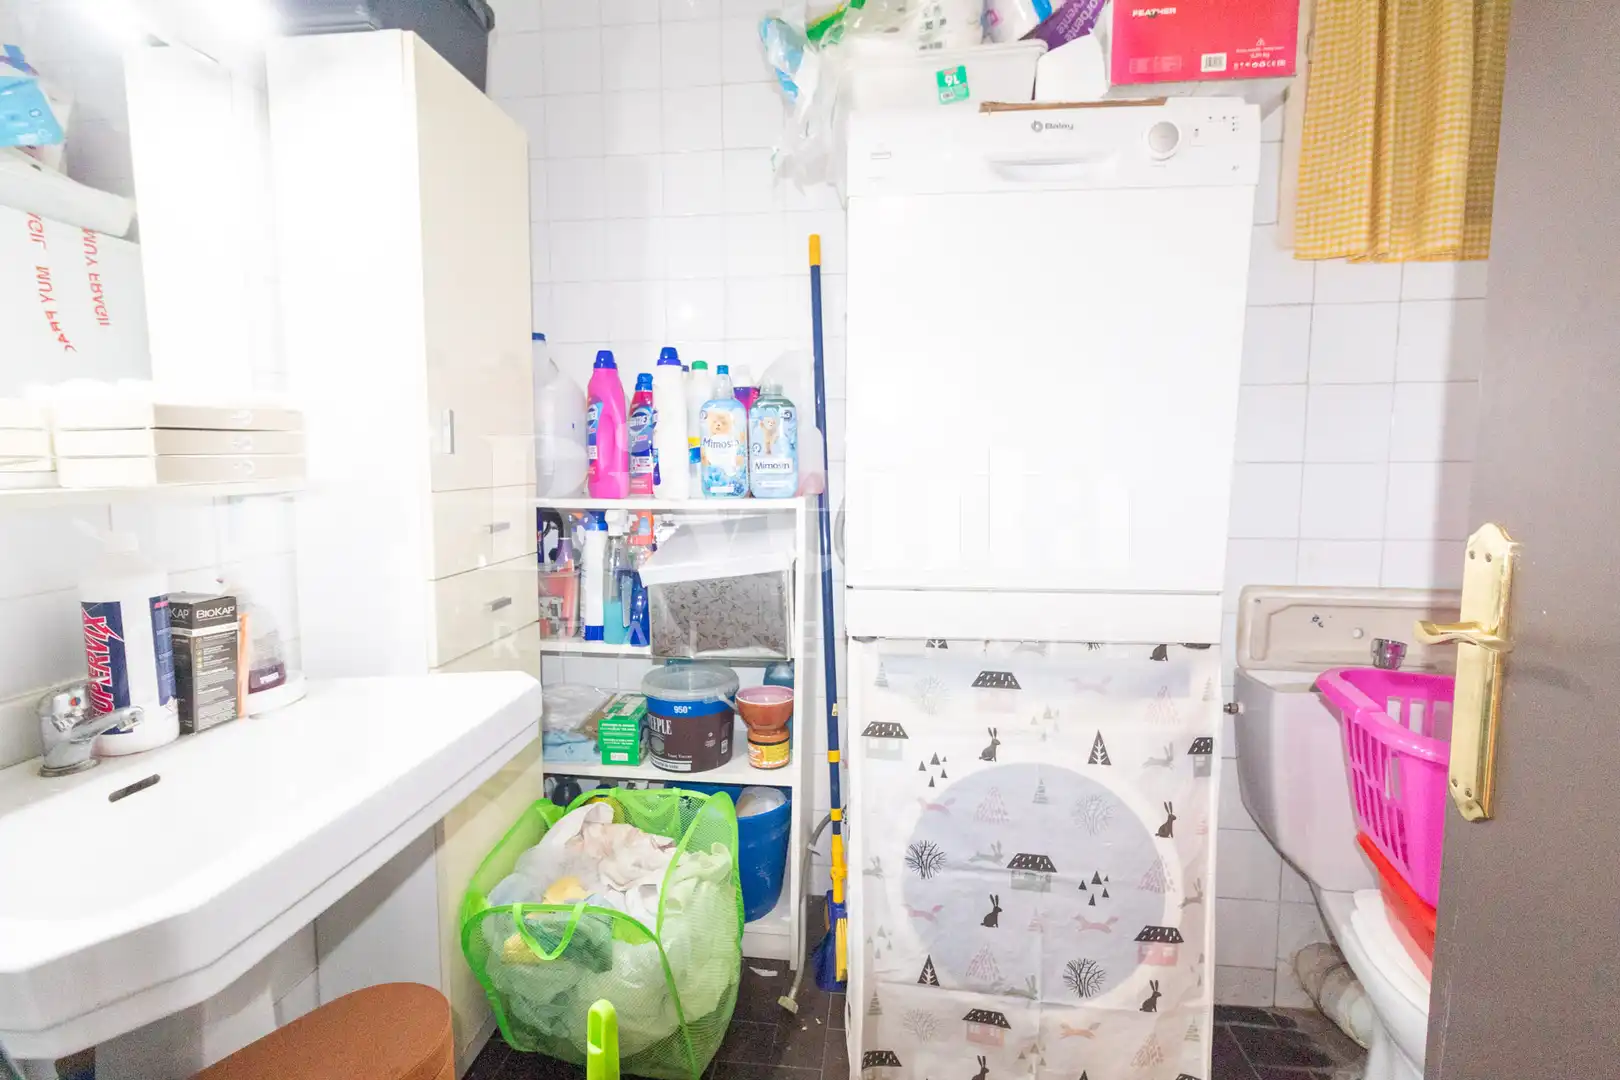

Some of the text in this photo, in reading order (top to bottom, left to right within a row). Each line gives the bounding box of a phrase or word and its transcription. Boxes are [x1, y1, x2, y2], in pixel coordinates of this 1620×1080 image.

[1132, 7, 1177, 17] FEATHER
[944, 74, 960, 87] 9L
[754, 461, 790, 471] Mimosin
[196, 605, 235, 619] BIOKAP
[81, 606, 118, 715] UPERVIX
